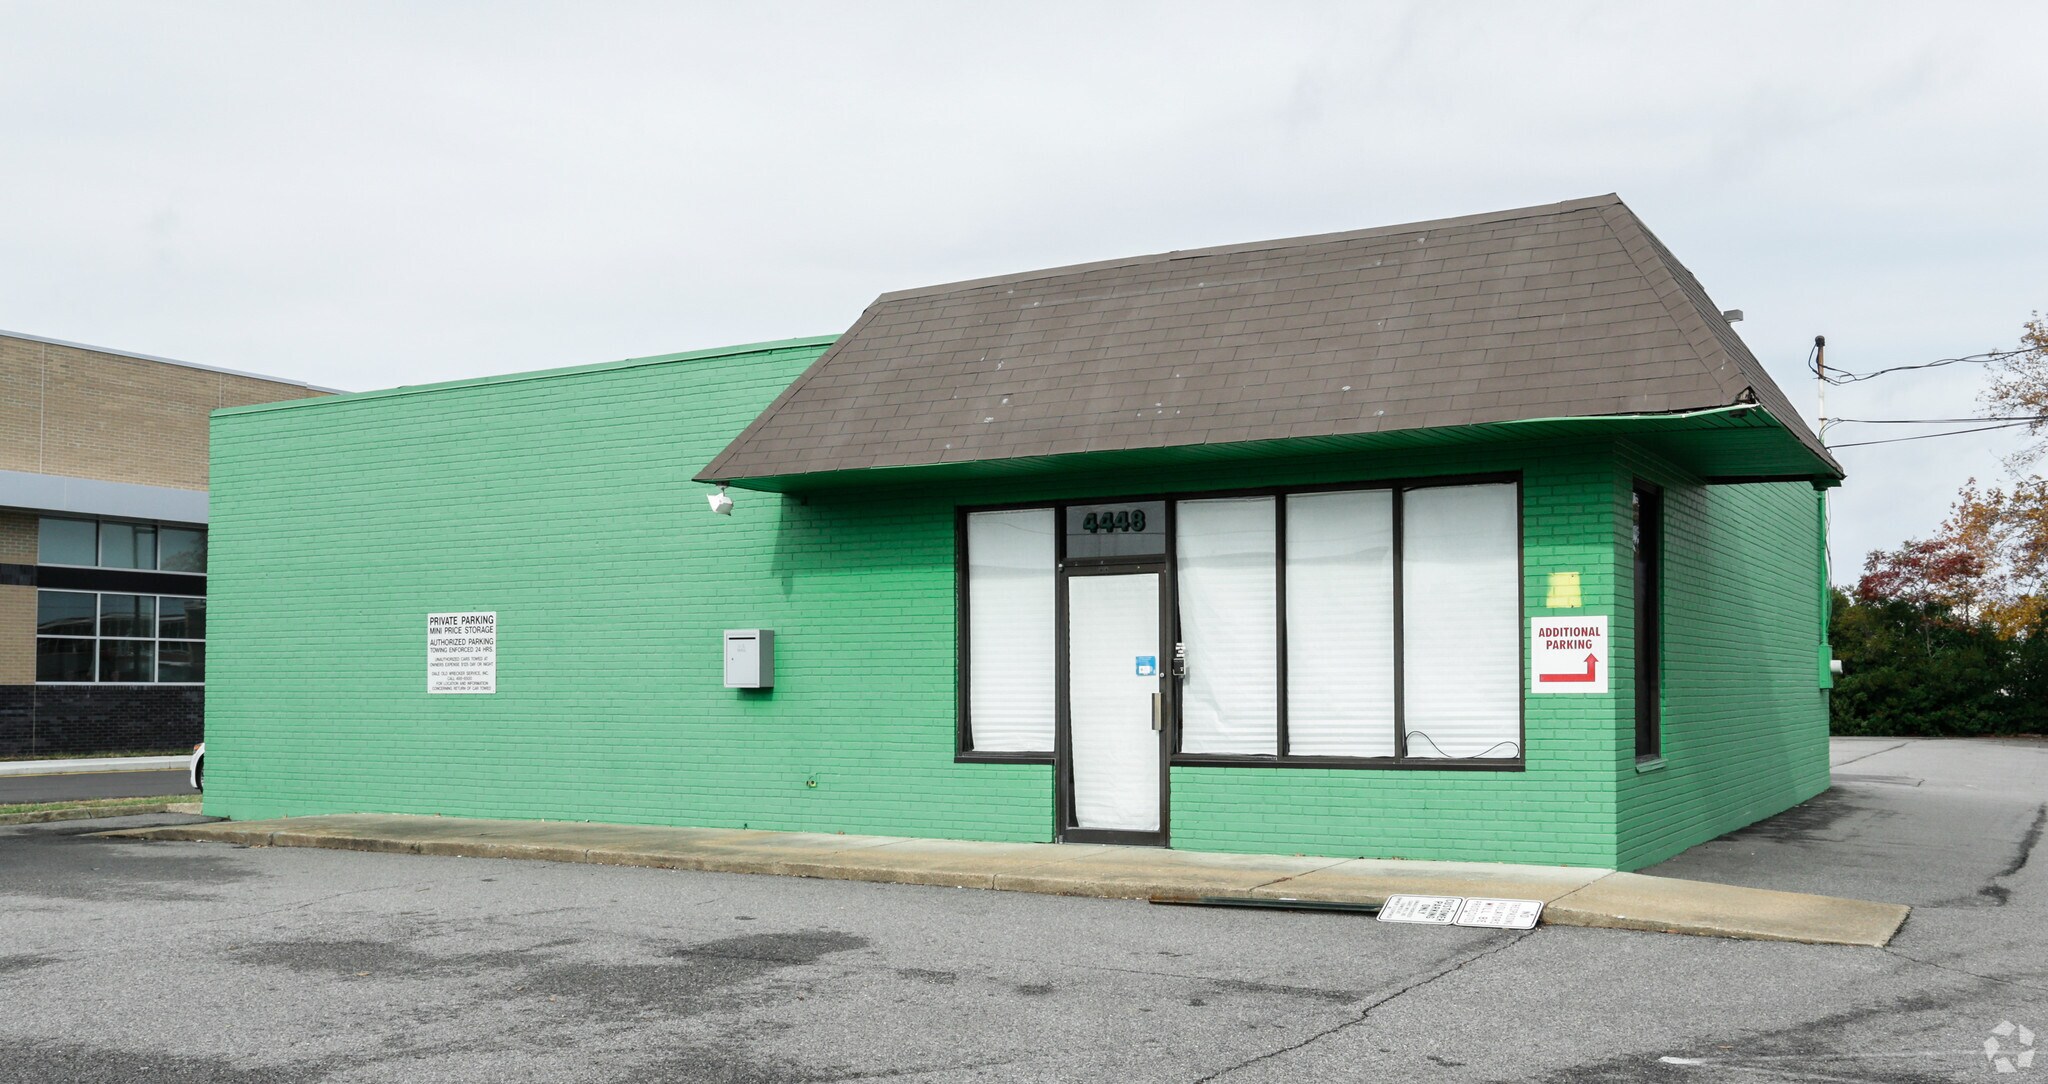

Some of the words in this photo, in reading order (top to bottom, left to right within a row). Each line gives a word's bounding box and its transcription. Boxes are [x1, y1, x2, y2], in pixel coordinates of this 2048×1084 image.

[1083, 509, 1146, 533] 4448
[430, 616, 458, 625] PRIVATE
[462, 615, 494, 624] PARKING
[1538, 626, 1600, 637] ADDITIONAL
[1546, 640, 1592, 650] PARKING
